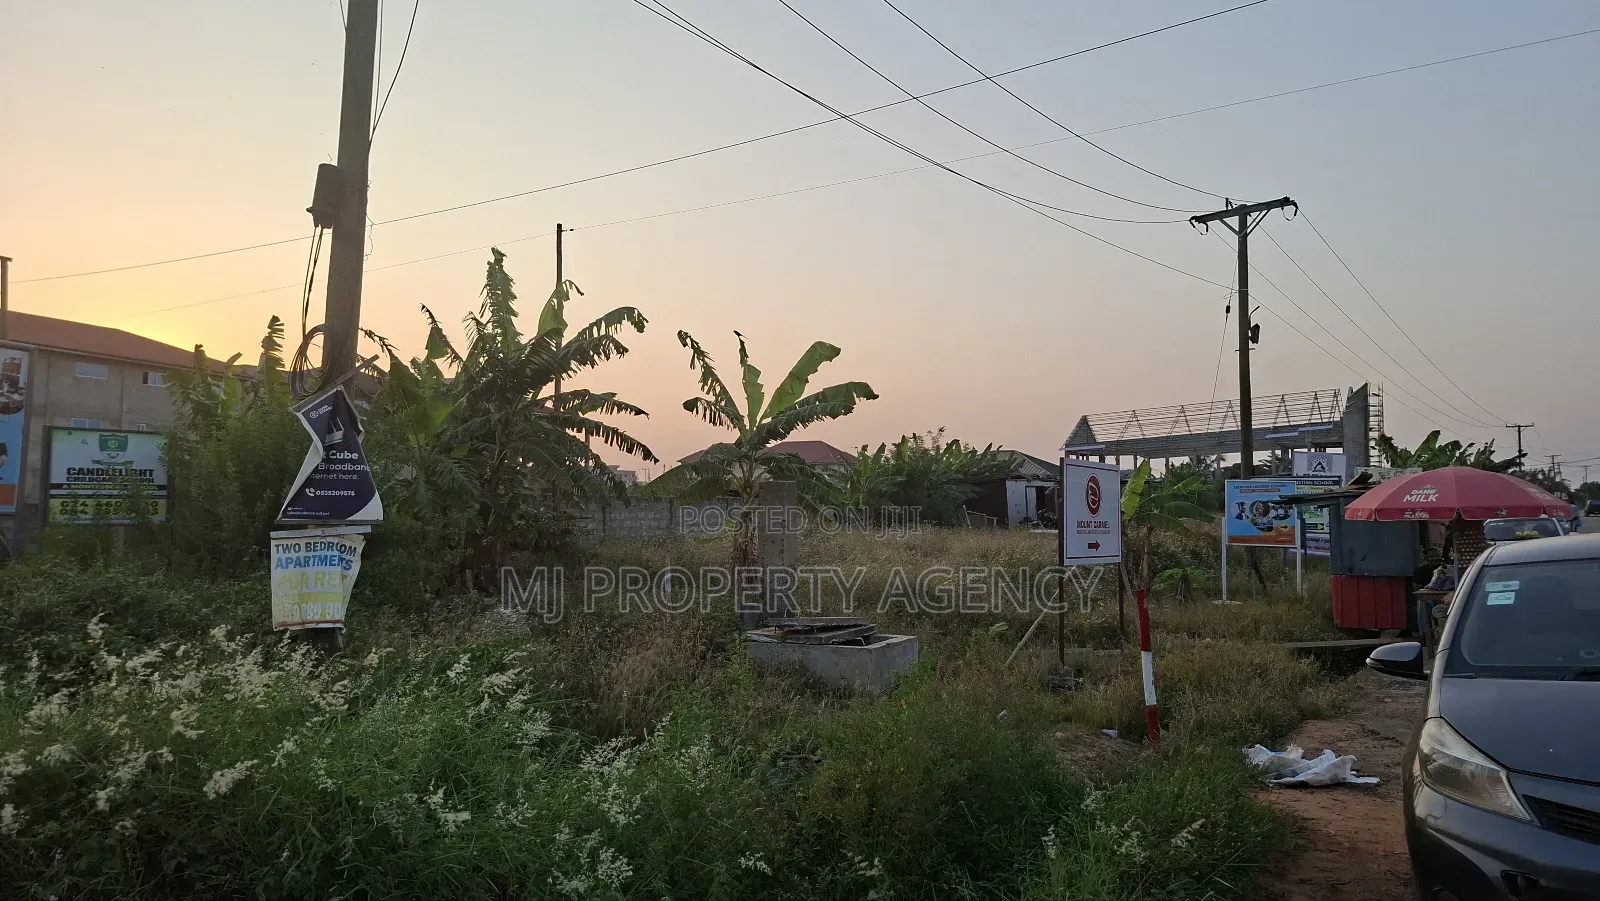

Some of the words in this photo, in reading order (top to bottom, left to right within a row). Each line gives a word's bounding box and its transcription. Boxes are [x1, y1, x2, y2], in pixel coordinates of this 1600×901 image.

[329, 450, 359, 460] Cube
[1403, 494, 1439, 503] MILK
[1076, 520, 1093, 529] MOUNT
[274, 543, 302, 554] TWO
